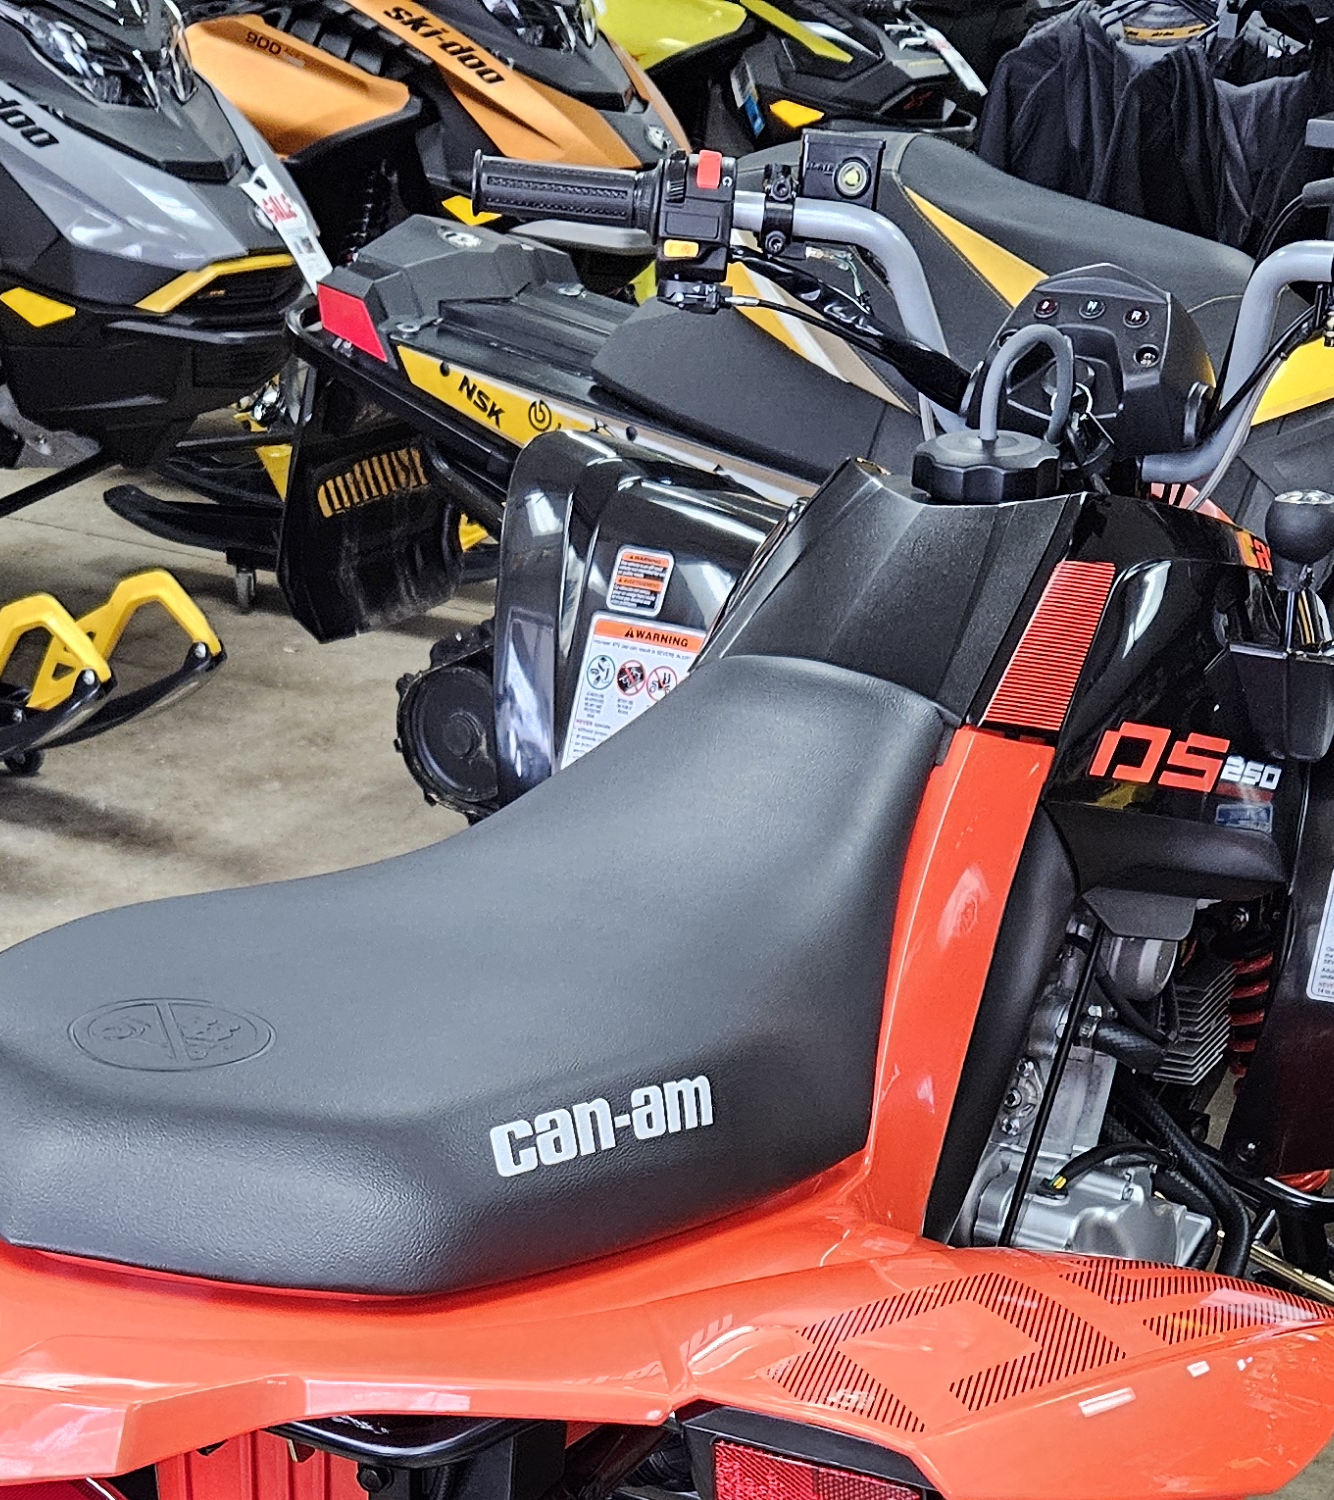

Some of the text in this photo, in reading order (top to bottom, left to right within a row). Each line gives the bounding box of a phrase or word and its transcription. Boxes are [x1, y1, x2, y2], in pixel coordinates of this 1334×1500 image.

[246, 31, 282, 55] 900
[384, 5, 506, 86] ski-doo
[458, 375, 505, 429] NSK
[636, 630, 689, 648] WARNING
[1220, 754, 1282, 790] 250
[489, 1073, 714, 1178] can-am
